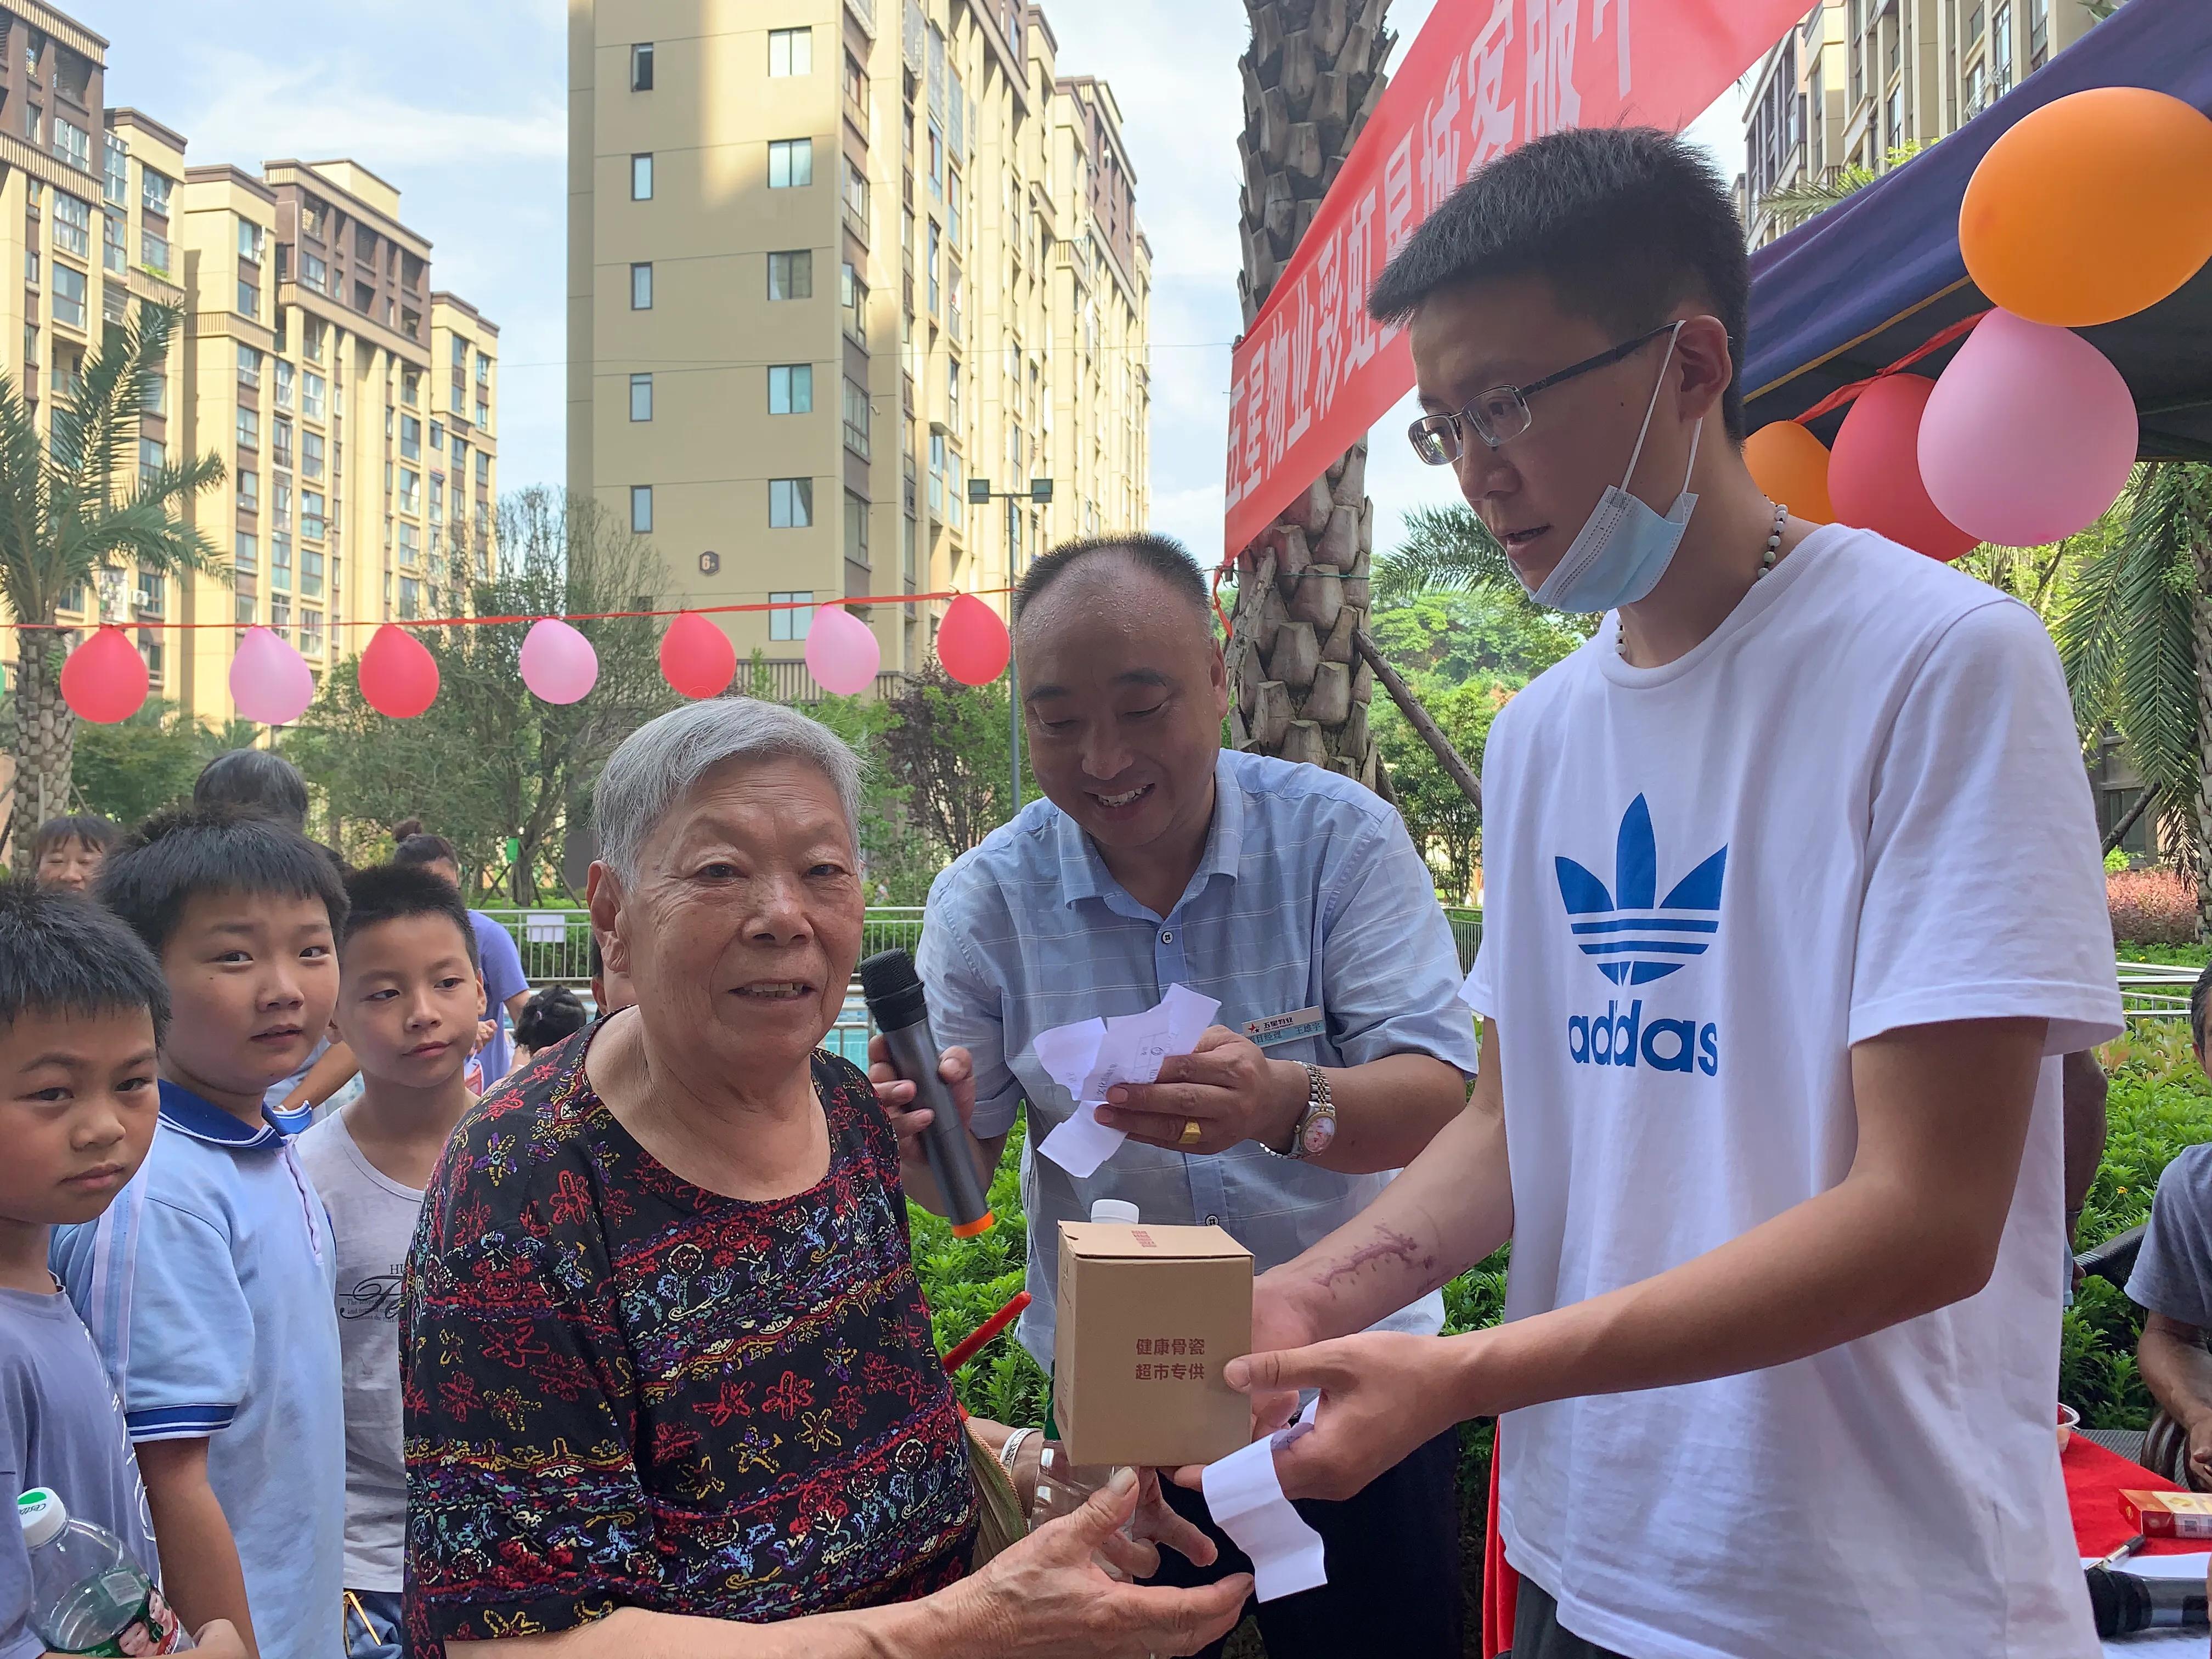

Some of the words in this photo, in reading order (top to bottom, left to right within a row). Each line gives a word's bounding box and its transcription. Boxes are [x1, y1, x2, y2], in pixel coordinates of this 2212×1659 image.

[1136, 1338, 1205, 1356] 健康骨瓷
[1135, 1363, 1205, 1380] 超市专供
